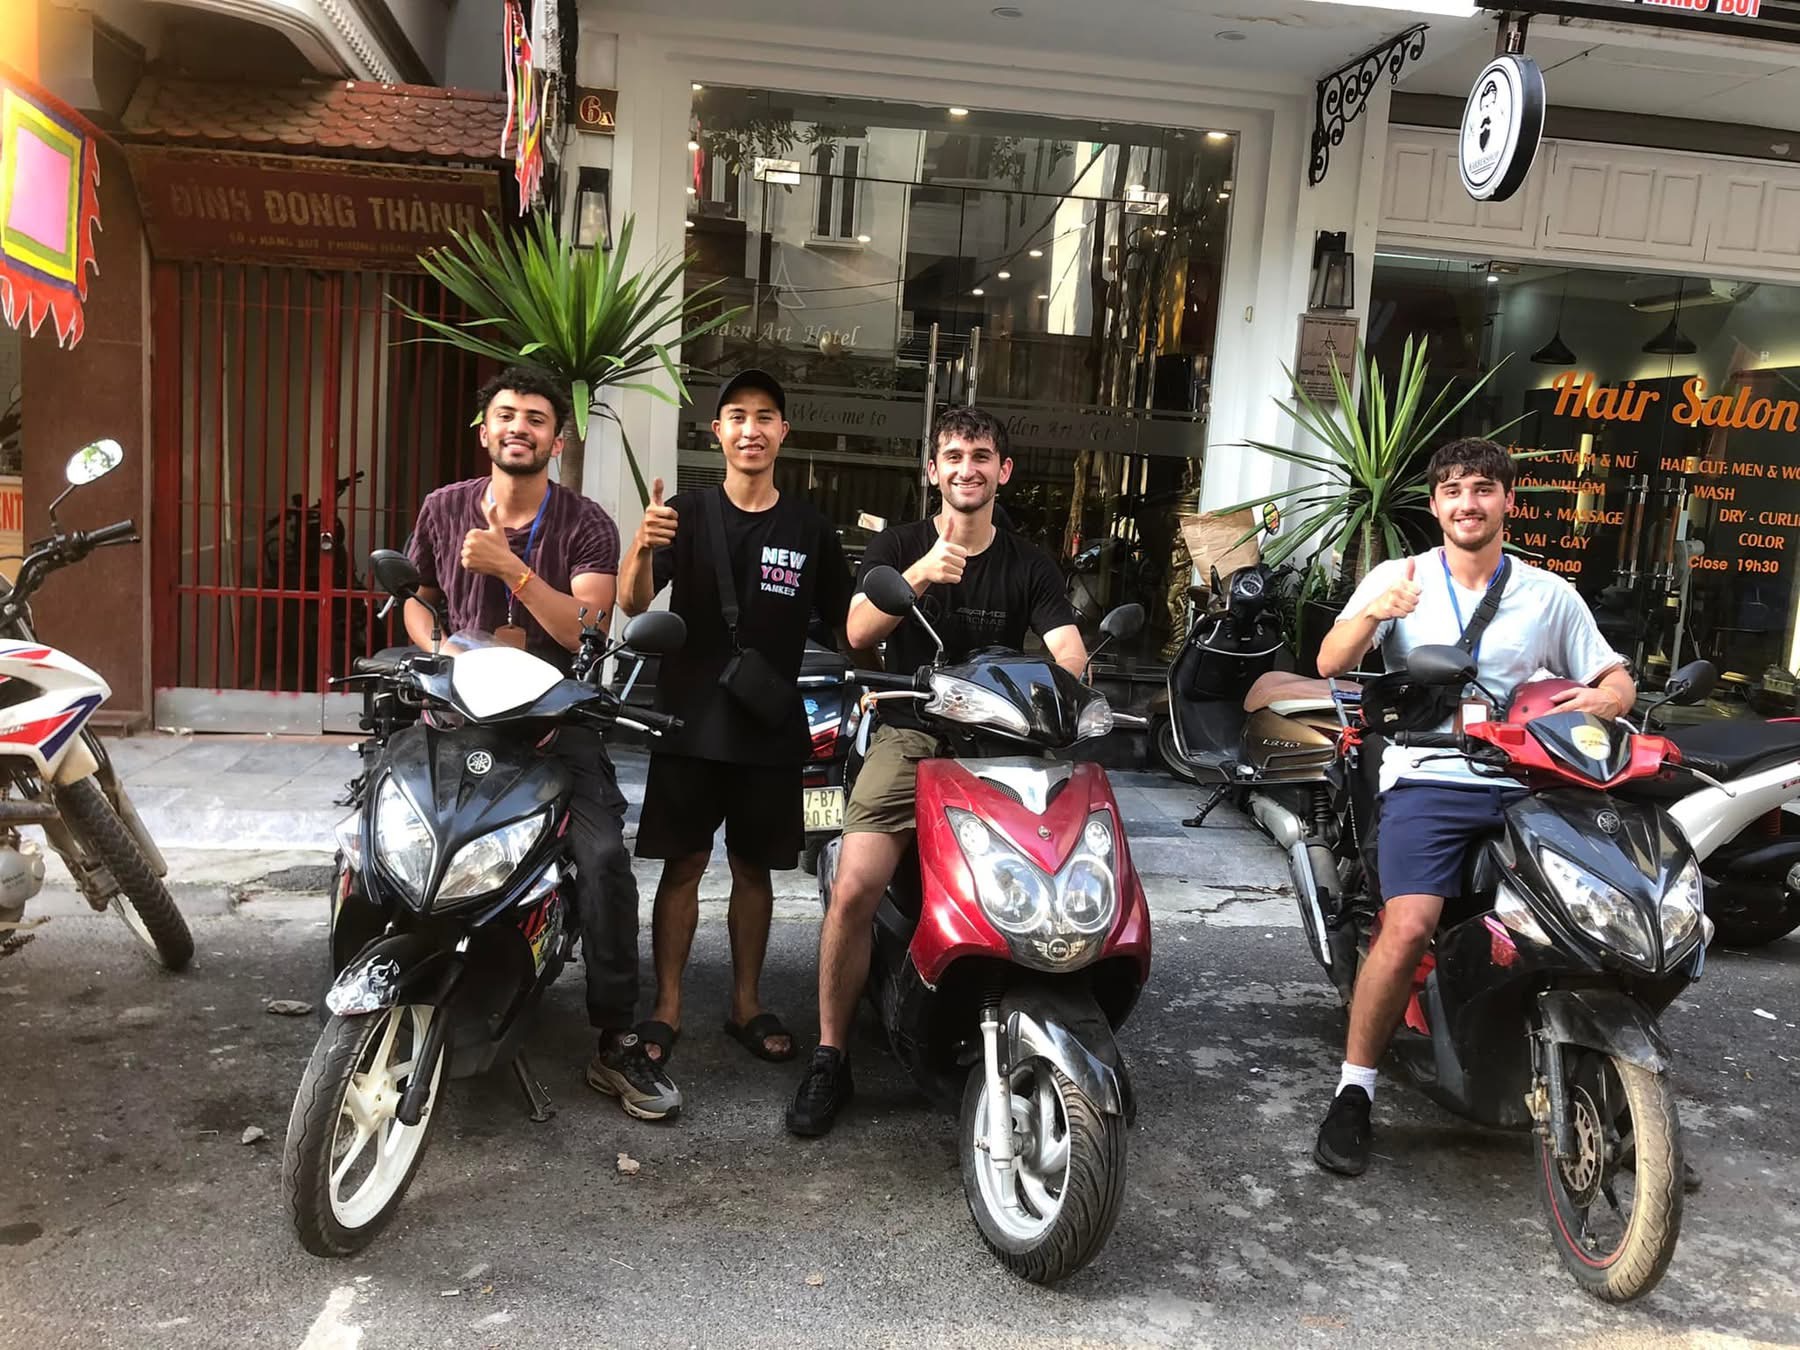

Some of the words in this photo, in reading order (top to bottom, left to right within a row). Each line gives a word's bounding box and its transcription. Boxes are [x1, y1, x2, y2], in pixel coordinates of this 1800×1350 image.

[580, 95, 615, 126] 6A
[755, 321, 792, 342] Art
[802, 324, 862, 346] Hotel
[1552, 370, 1660, 422] Hair
[1672, 377, 1800, 433] Salon
[871, 408, 887, 427] to
[1561, 451, 1596, 467] NAM
[1600, 454, 1611, 468] &
[1660, 457, 1694, 472] HAIR
[1699, 460, 1728, 475] CUT:
[1732, 462, 1763, 478] MEN
[1767, 465, 1778, 478] &
[1694, 485, 1736, 501] WASH
[0, 491, 23, 530] NT
[1557, 508, 1625, 525] MASSAGE
[1720, 508, 1747, 523] DRY
[1524, 533, 1547, 547] VAI
[1738, 533, 1785, 550] COLOR
[761, 546, 807, 570] NEW
[1547, 558, 1582, 573] 9h00
[1688, 555, 1729, 571] Close
[1738, 558, 1779, 573] 19h30
[760, 565, 801, 587] YORK
